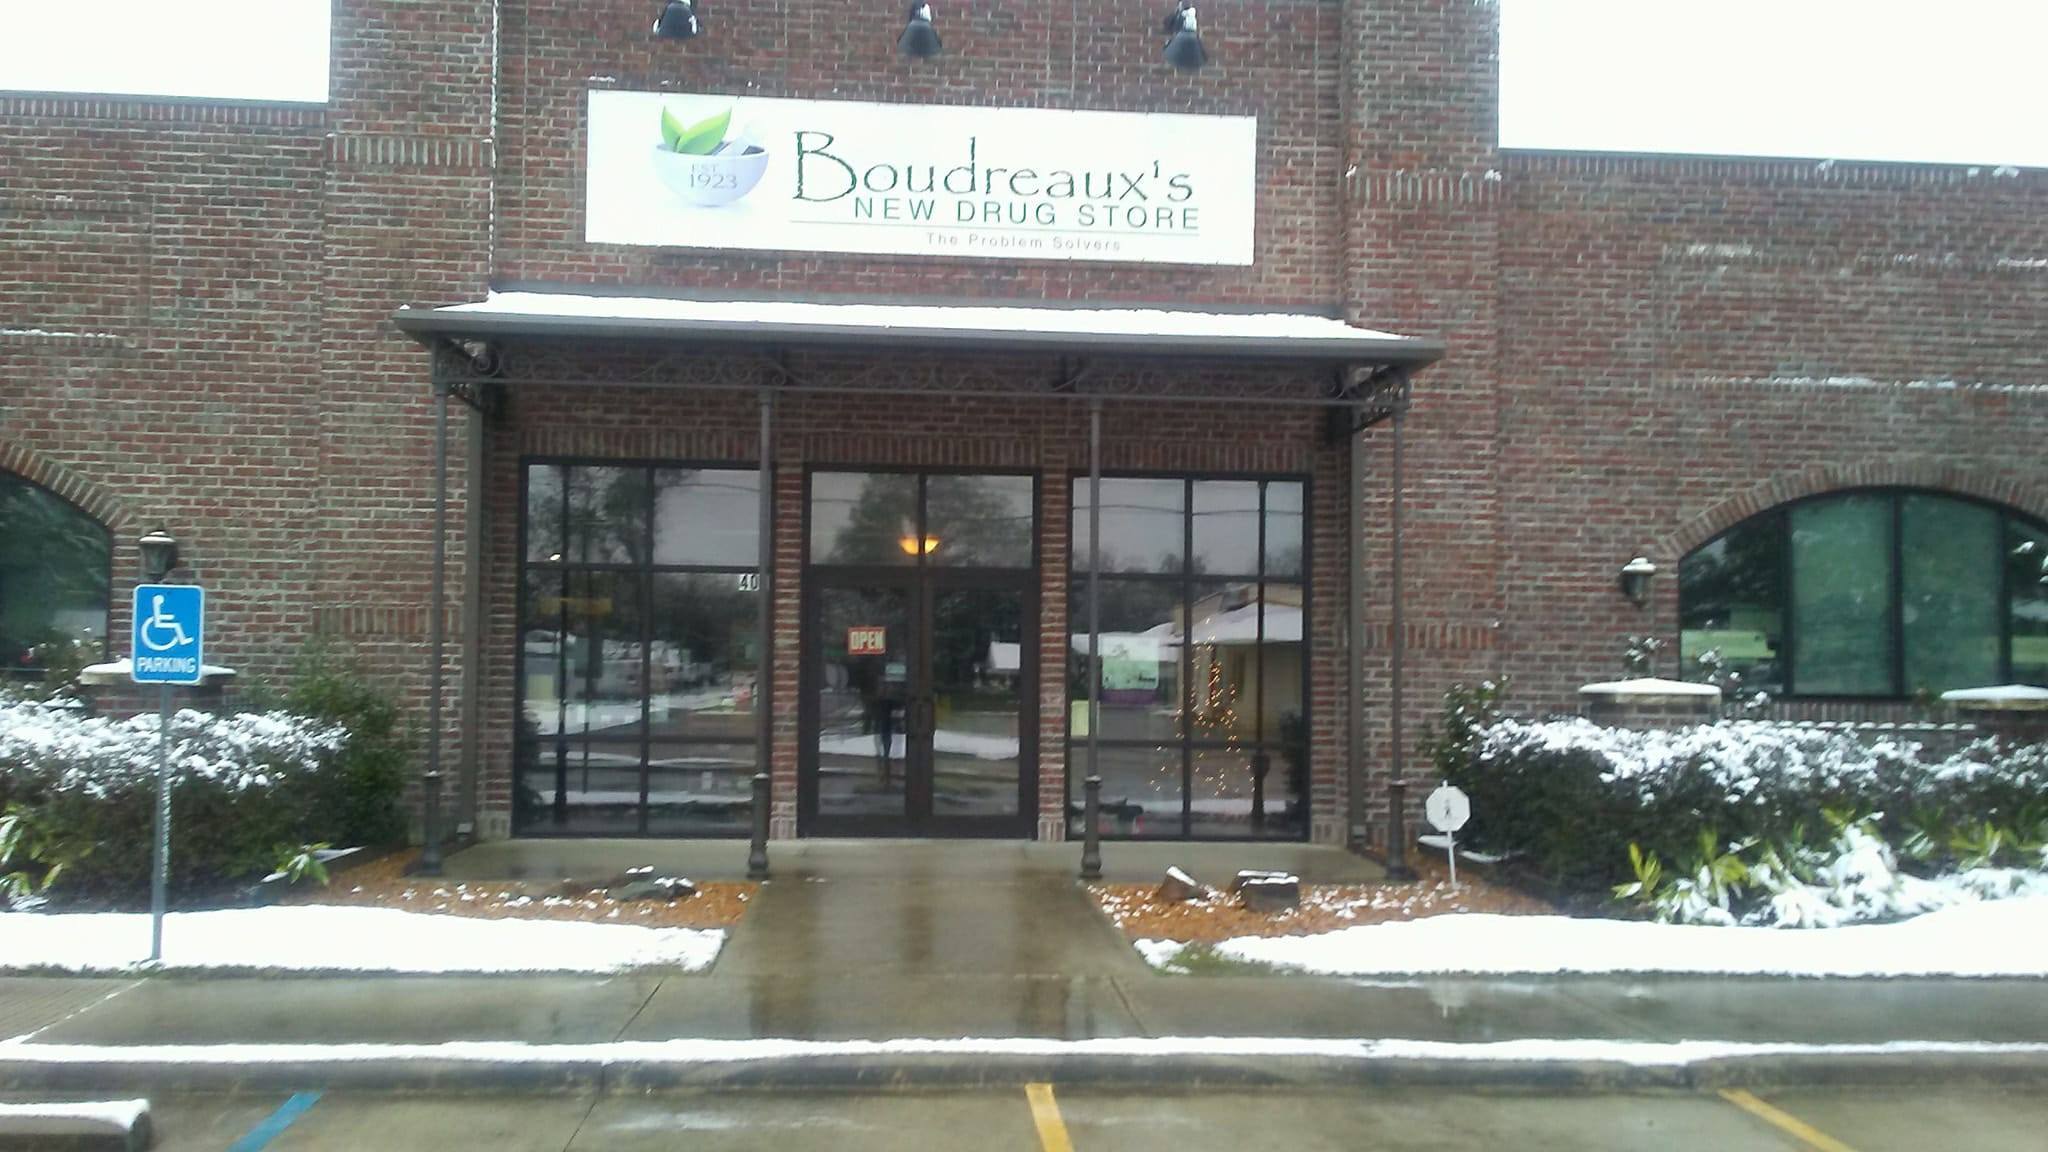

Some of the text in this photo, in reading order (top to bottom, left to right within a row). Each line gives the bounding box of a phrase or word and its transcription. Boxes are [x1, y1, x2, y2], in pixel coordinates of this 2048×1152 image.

[793, 131, 1193, 202] Boudreaux's
[690, 173, 738, 190] 1923
[854, 197, 1199, 230] NEW DRUG STORE
[927, 232, 1121, 253] The Problem Solvers
[850, 631, 884, 650] OPEN
[136, 657, 196, 673] PARKING
